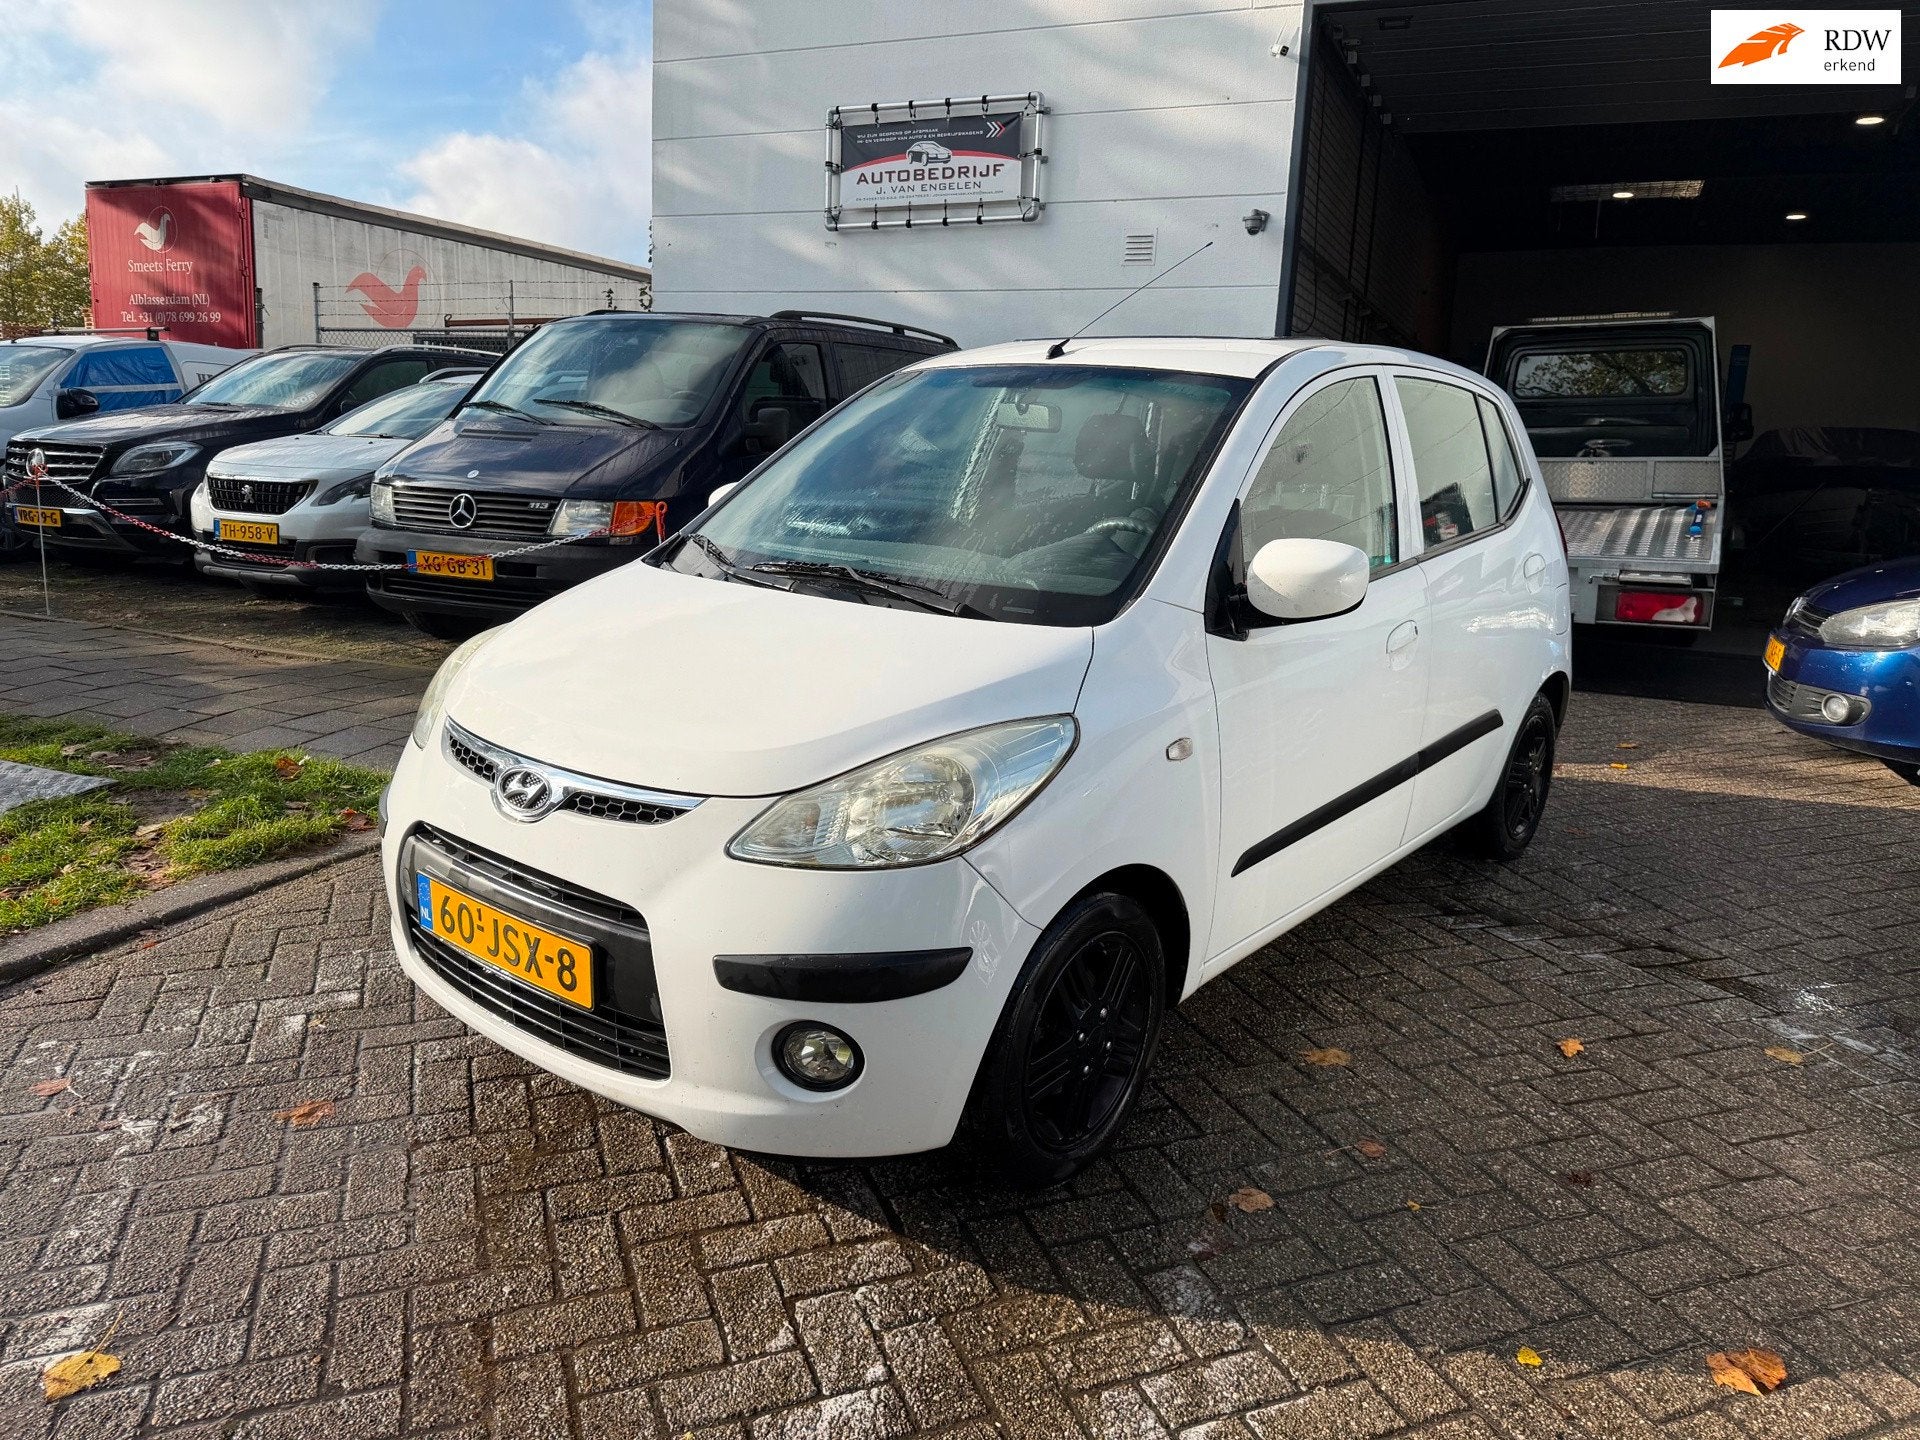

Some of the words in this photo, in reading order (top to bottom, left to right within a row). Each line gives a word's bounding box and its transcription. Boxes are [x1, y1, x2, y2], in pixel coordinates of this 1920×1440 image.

[937, 130, 984, 138] BEDRIJFSWAGENS
[856, 163, 1005, 186] AUTOBEDRIJF
[875, 187, 886, 195] J.
[890, 185, 915, 194] VAN
[920, 181, 982, 193] ENGELEN
[127, 260, 164, 273] Smeets
[166, 258, 193, 275] Ferry
[128, 294, 191, 306] Alblasserdam
[191, 293, 210, 308] (NL)
[120, 311, 137, 323] Tel.
[138, 312, 153, 323] +31
[178, 312, 195, 323] 699
[197, 312, 208, 323] 26
[209, 312, 221, 323] 99
[222, 523, 274, 541] TH-958-V
[422, 555, 487, 577] XGGB-31
[420, 905, 432, 922] NL
[440, 895, 578, 992] 60-JSX-8
